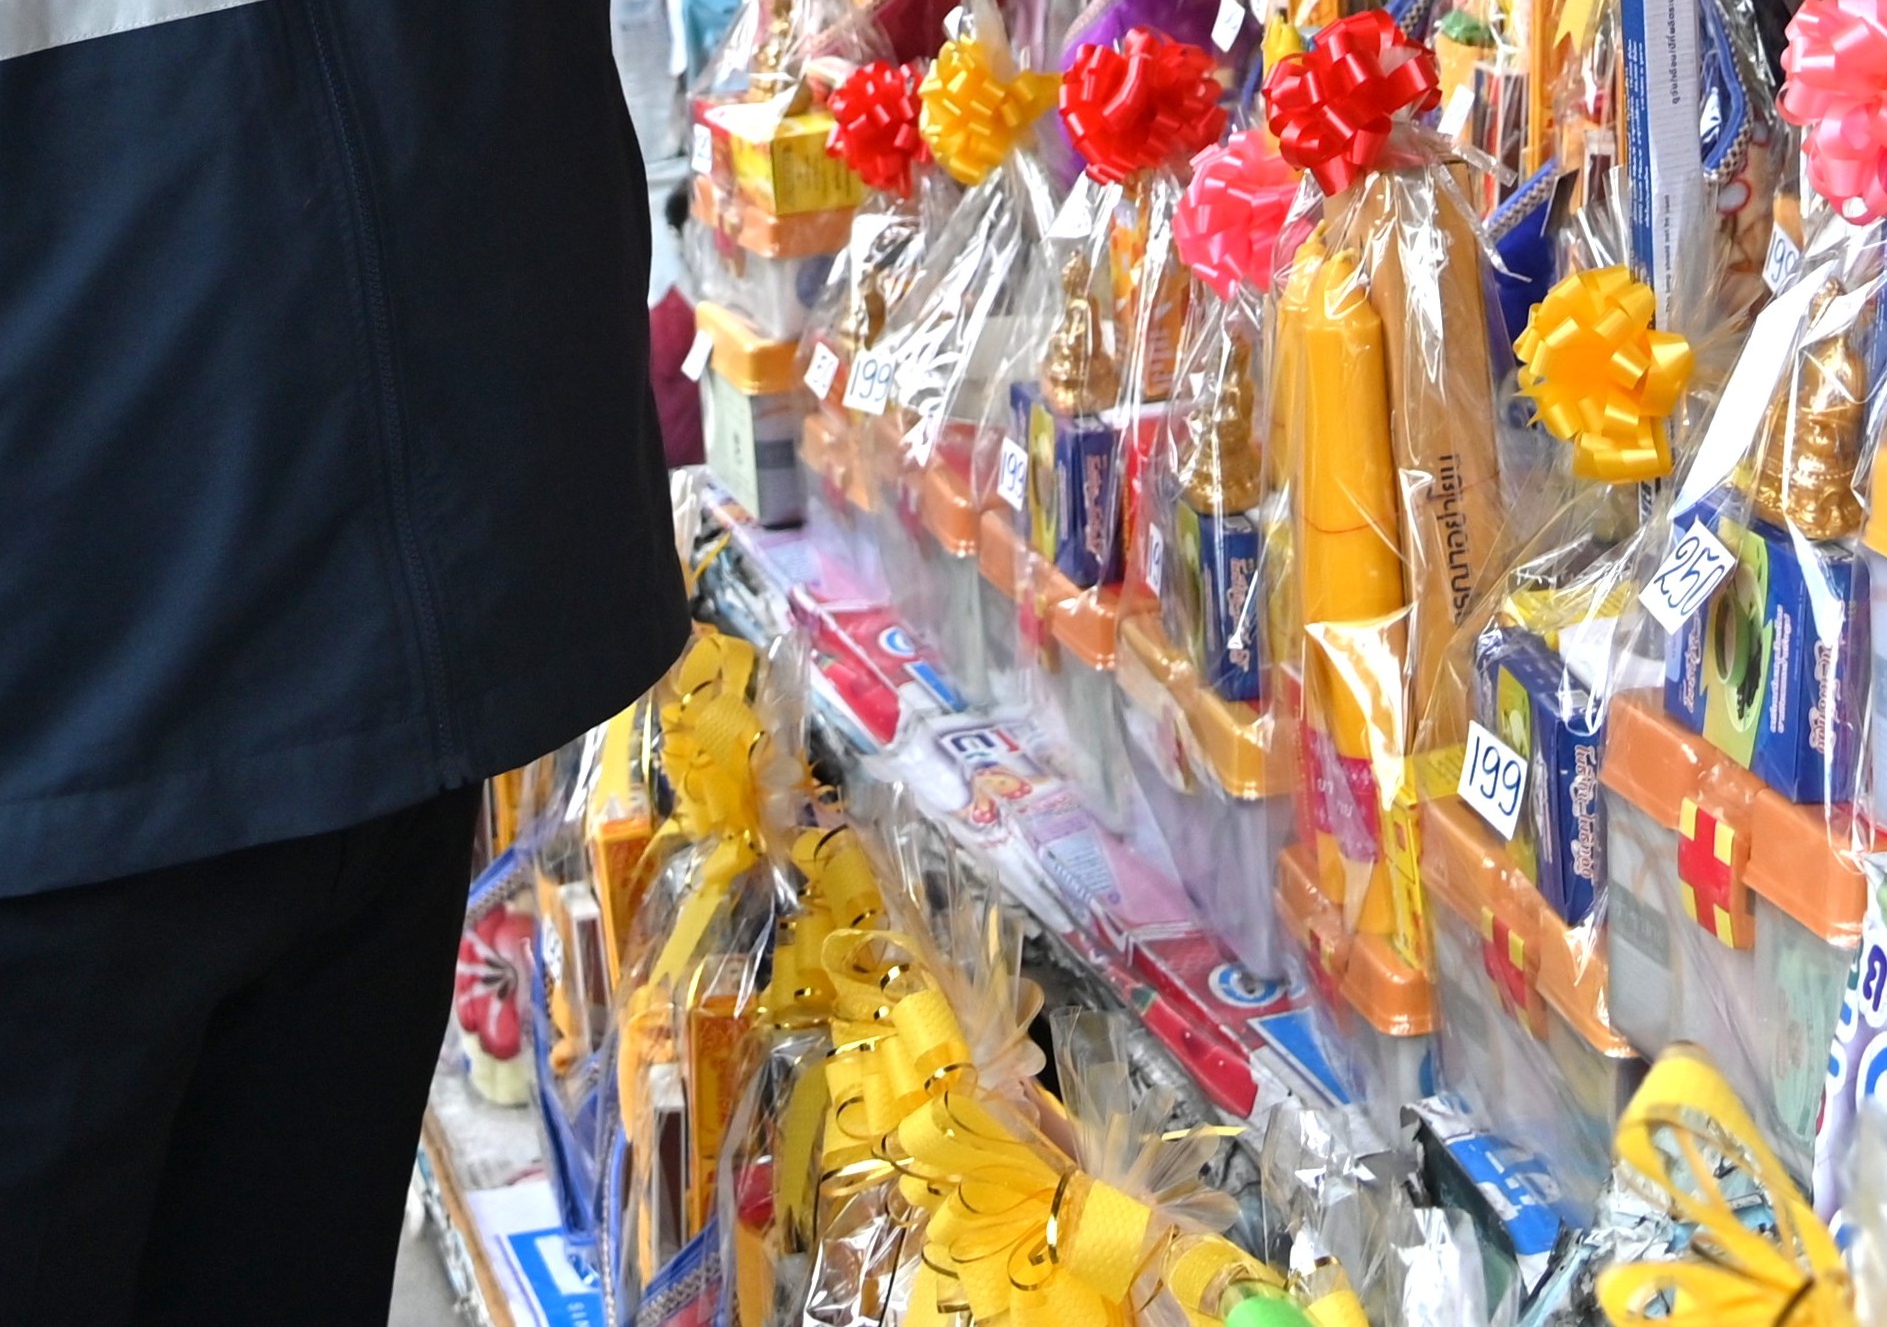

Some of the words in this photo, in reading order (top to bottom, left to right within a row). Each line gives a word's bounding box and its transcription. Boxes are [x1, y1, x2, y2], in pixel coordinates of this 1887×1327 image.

[849, 358, 894, 402] 199
[1002, 451, 1025, 499] 199
[1424, 453, 1481, 627] รุณาอย่าโยน
[1653, 535, 1725, 616] 250
[1469, 736, 1522, 817] 199
